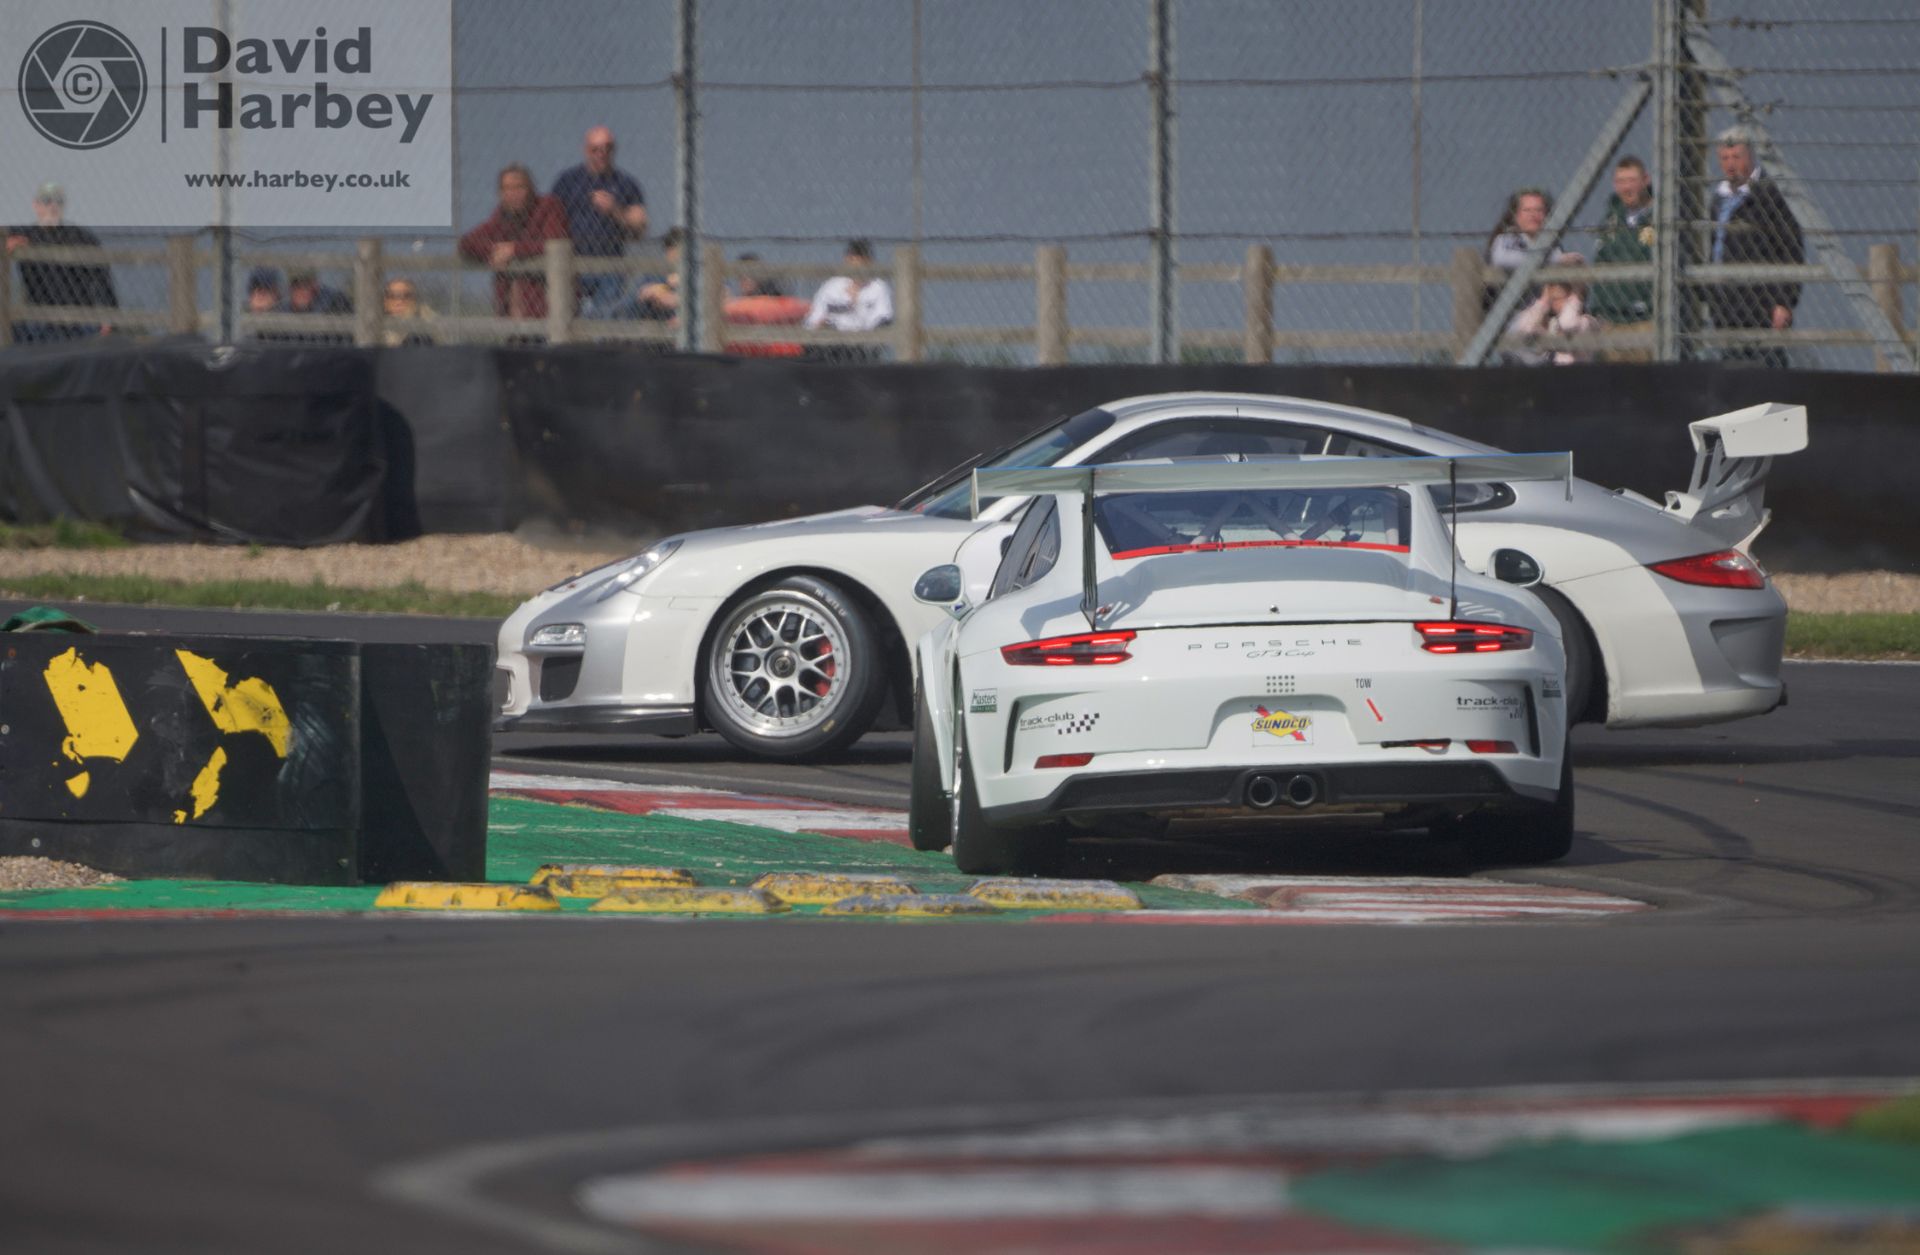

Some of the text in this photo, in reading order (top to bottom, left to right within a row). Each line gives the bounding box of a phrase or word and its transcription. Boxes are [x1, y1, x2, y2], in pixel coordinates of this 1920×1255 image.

[1188, 639, 1362, 650] PORSCHE
[1355, 678, 1372, 689] TOW
[1020, 712, 1075, 726] track-club
[1255, 717, 1308, 731] SUNOCO
